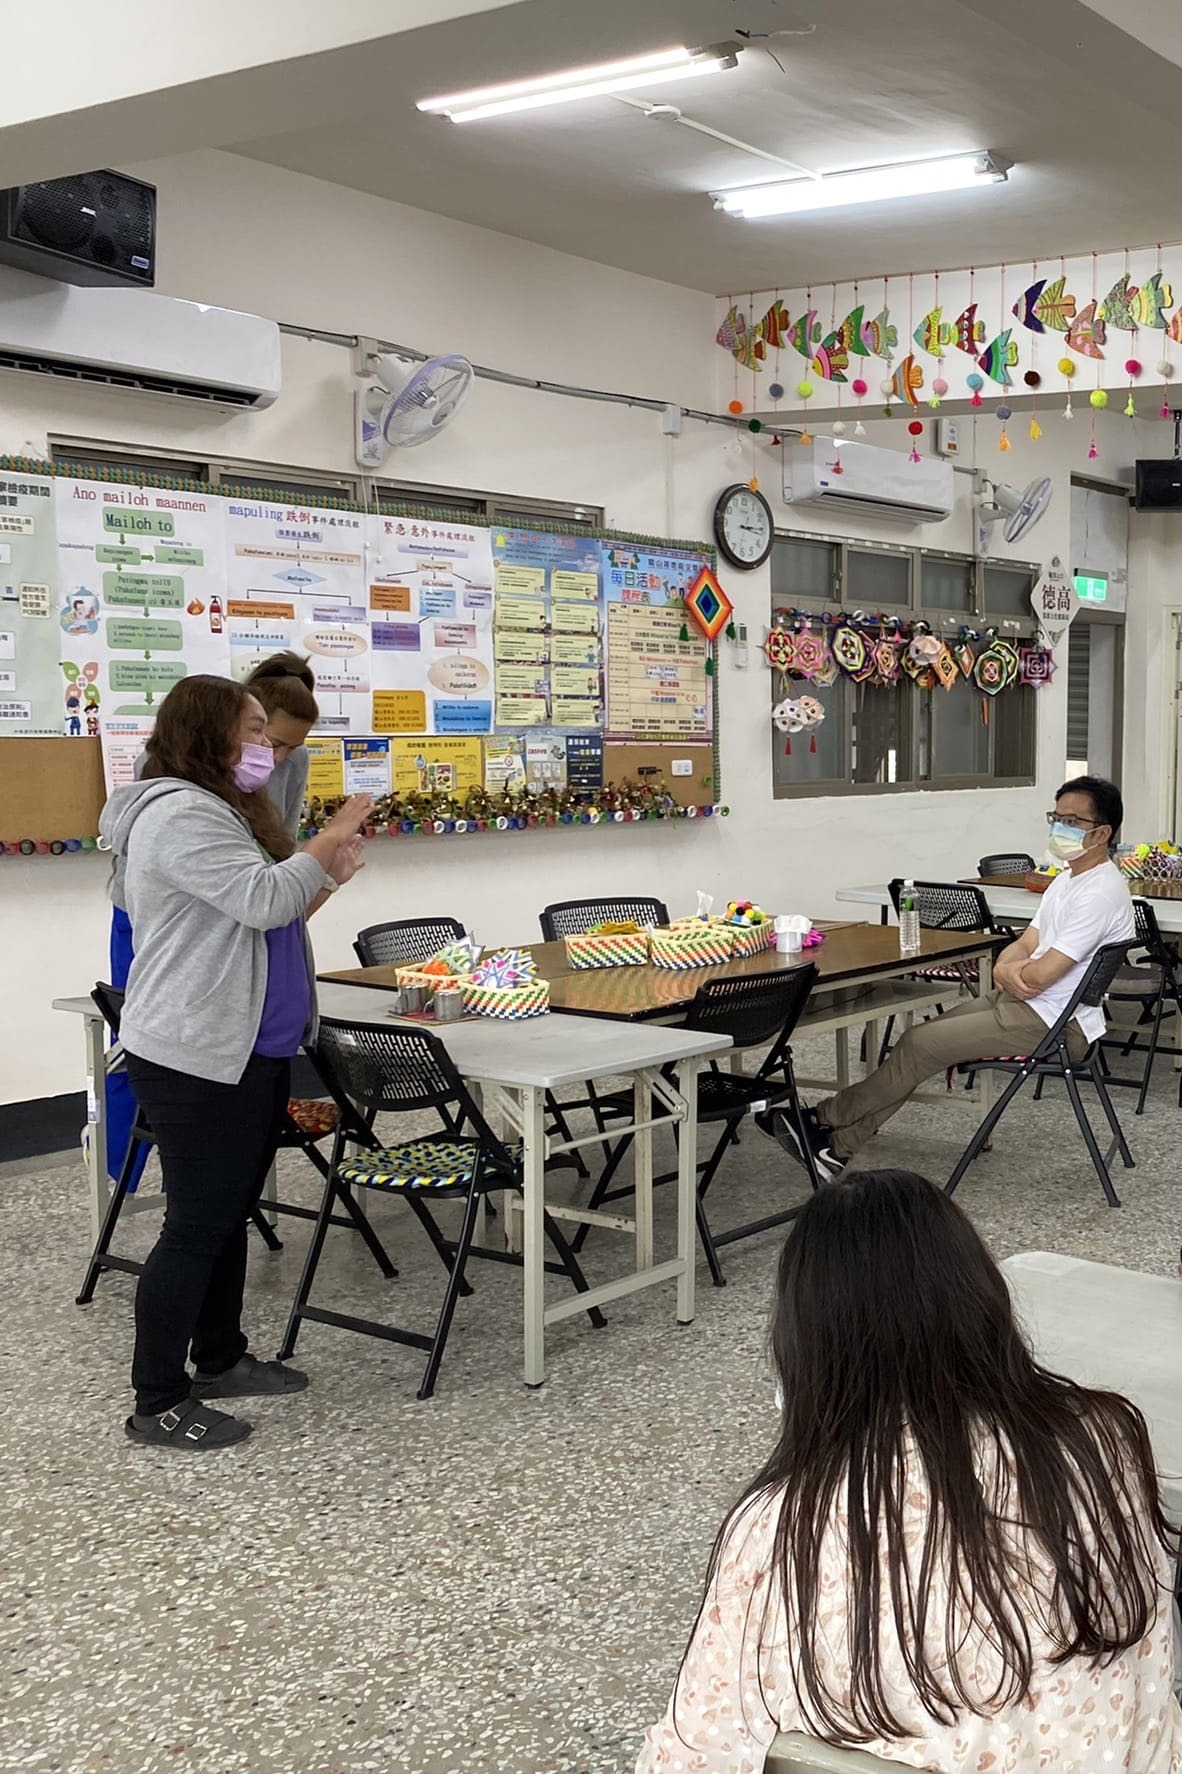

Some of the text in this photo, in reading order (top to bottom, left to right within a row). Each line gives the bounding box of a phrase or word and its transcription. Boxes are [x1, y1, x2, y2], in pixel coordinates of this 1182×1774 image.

[73, 486, 206, 513] Ano mailoh maannen
[106, 513, 173, 532] Mailoh to
[229, 505, 283, 522] mapuling
[611, 569, 660, 591] 每日活動
[1042, 584, 1071, 611] 德高
